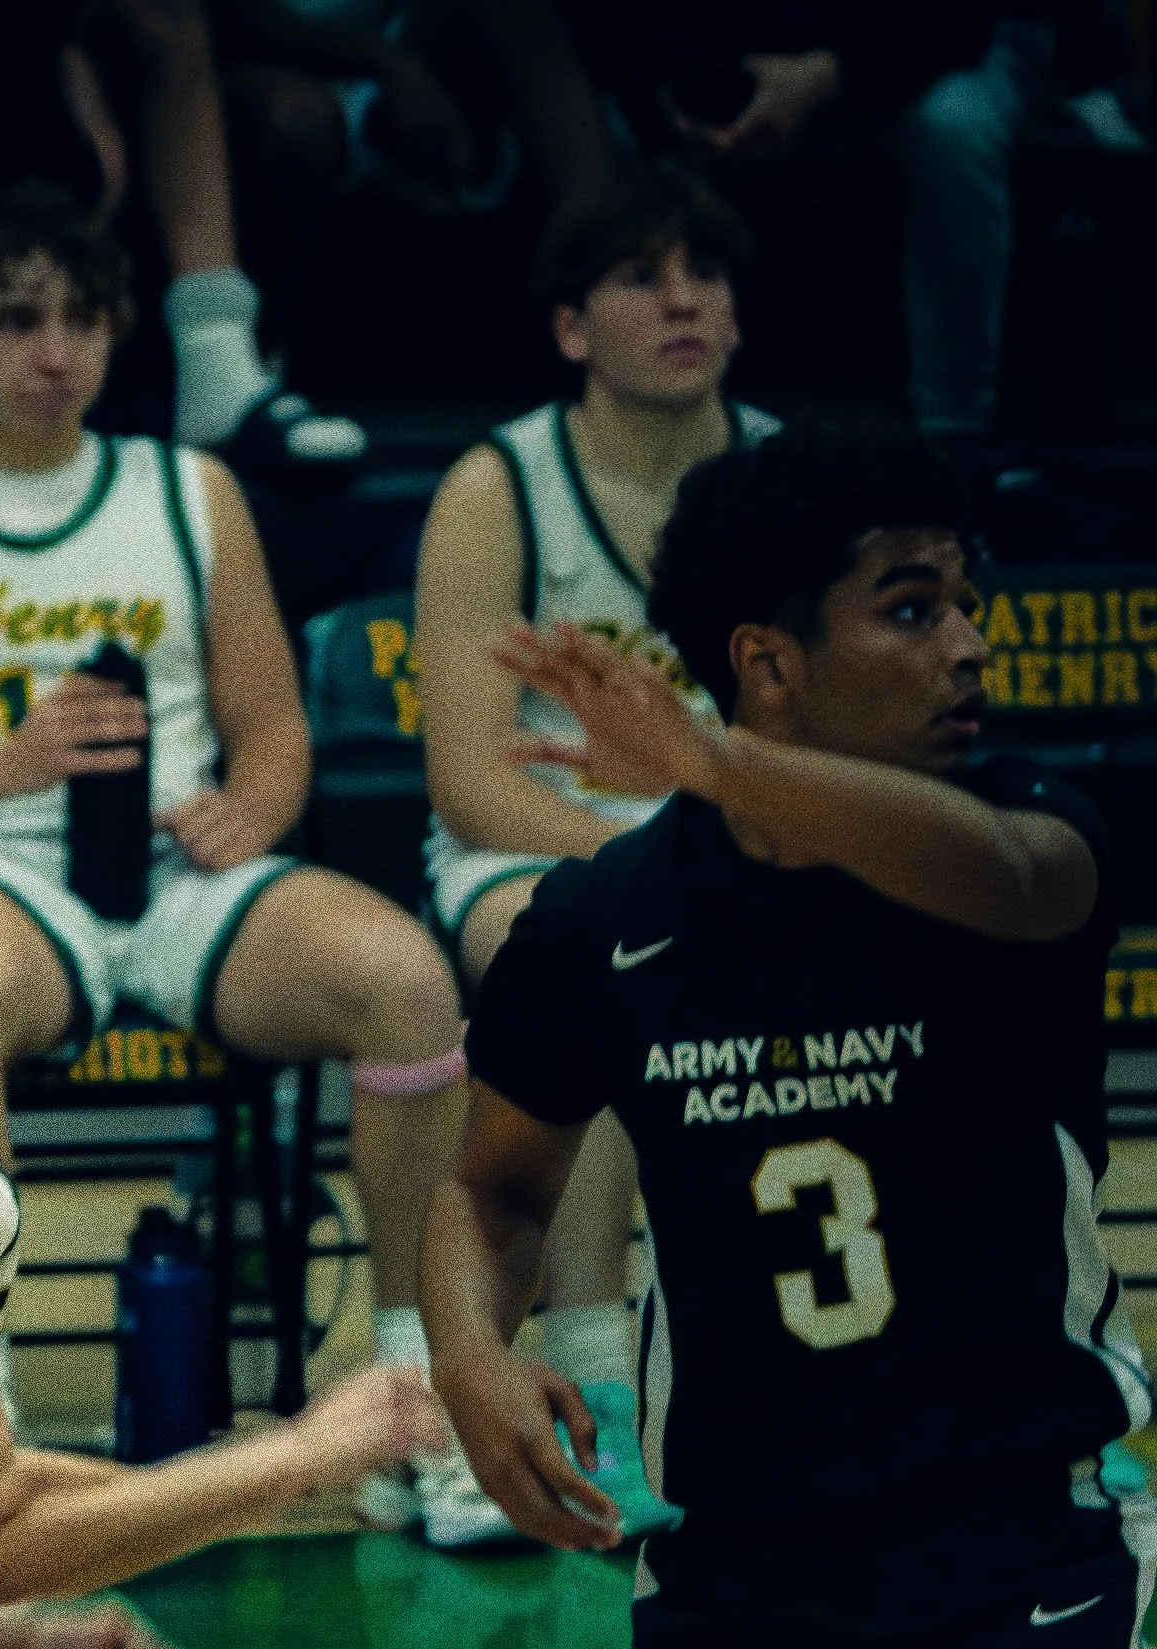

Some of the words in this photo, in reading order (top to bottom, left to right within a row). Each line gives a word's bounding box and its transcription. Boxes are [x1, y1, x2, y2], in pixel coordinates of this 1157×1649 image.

[971, 586, 1157, 645] ATRIC
[645, 1034, 765, 1084] ARMY
[770, 1034, 799, 1070] &
[803, 1019, 925, 1070] NAVY
[683, 1068, 898, 1127] ACADEMY
[748, 1134, 898, 1351] 3
